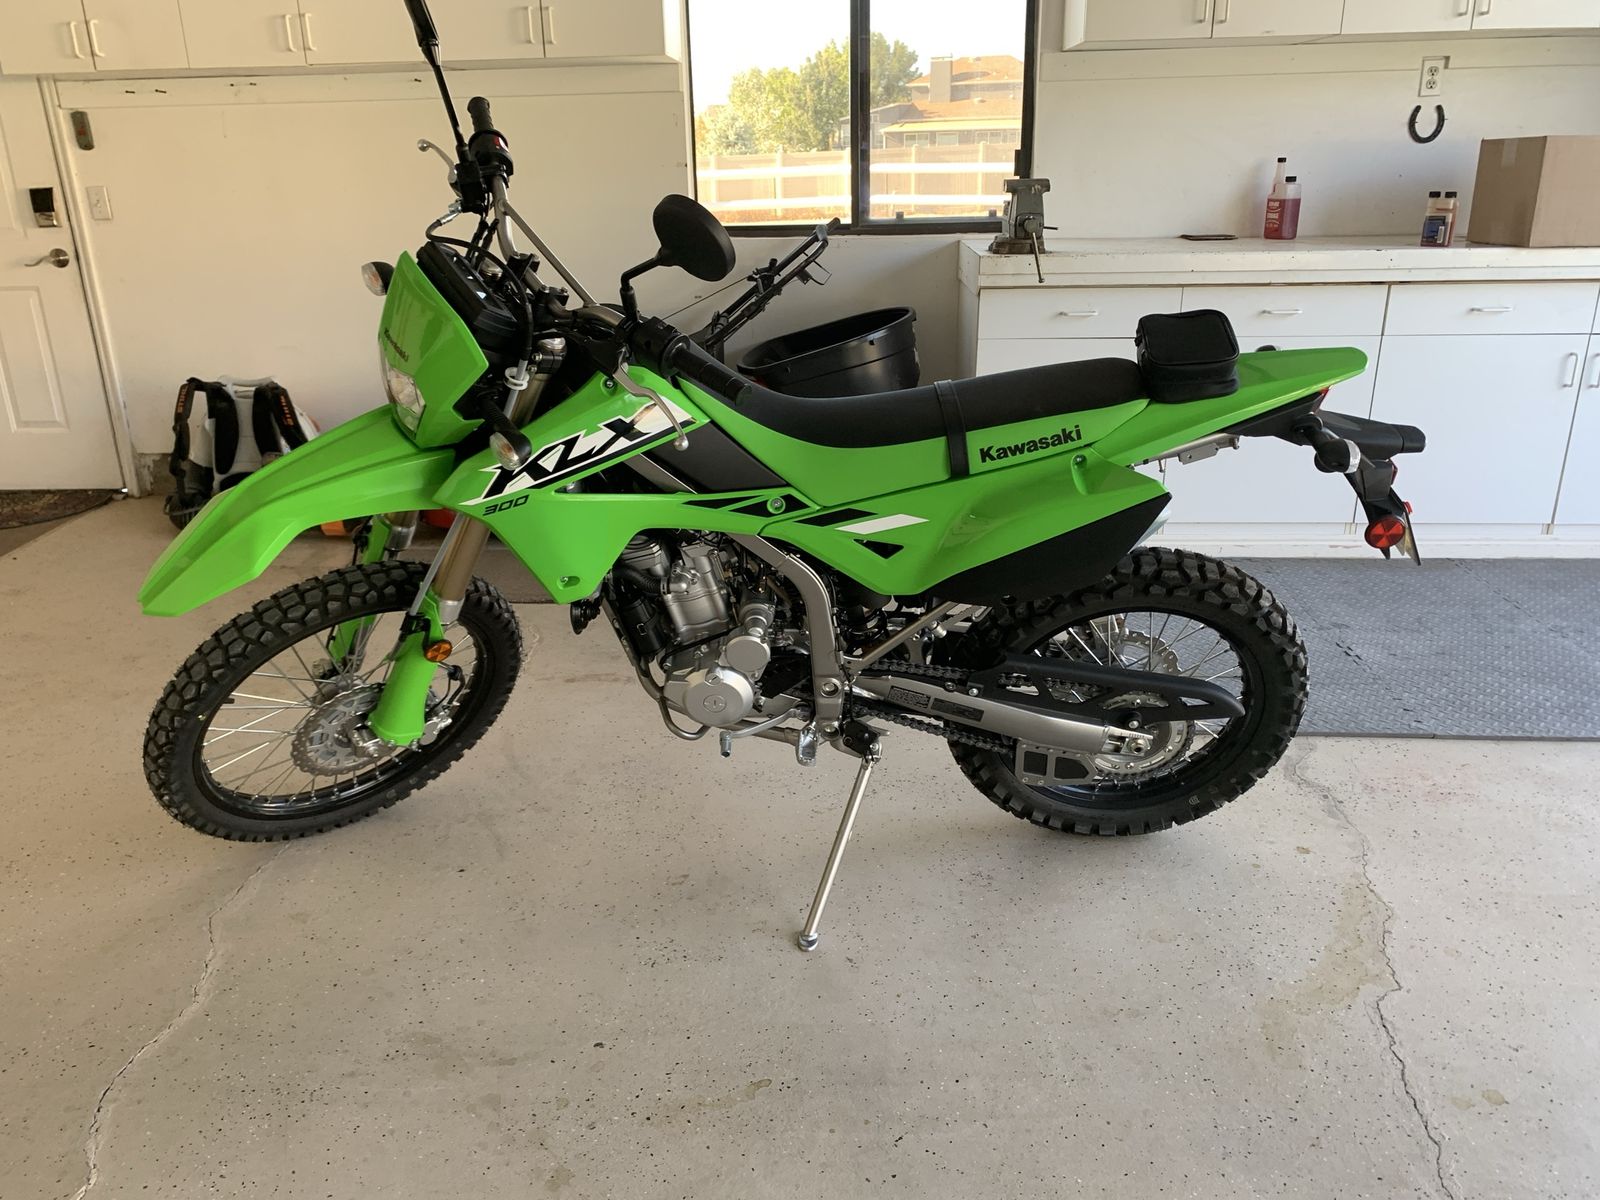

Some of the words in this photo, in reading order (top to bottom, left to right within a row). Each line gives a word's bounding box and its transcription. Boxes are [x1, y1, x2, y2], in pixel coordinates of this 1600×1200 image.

[481, 402, 658, 500] KLX
[979, 424, 1082, 463] Kawasaki
[483, 494, 530, 516] 300
